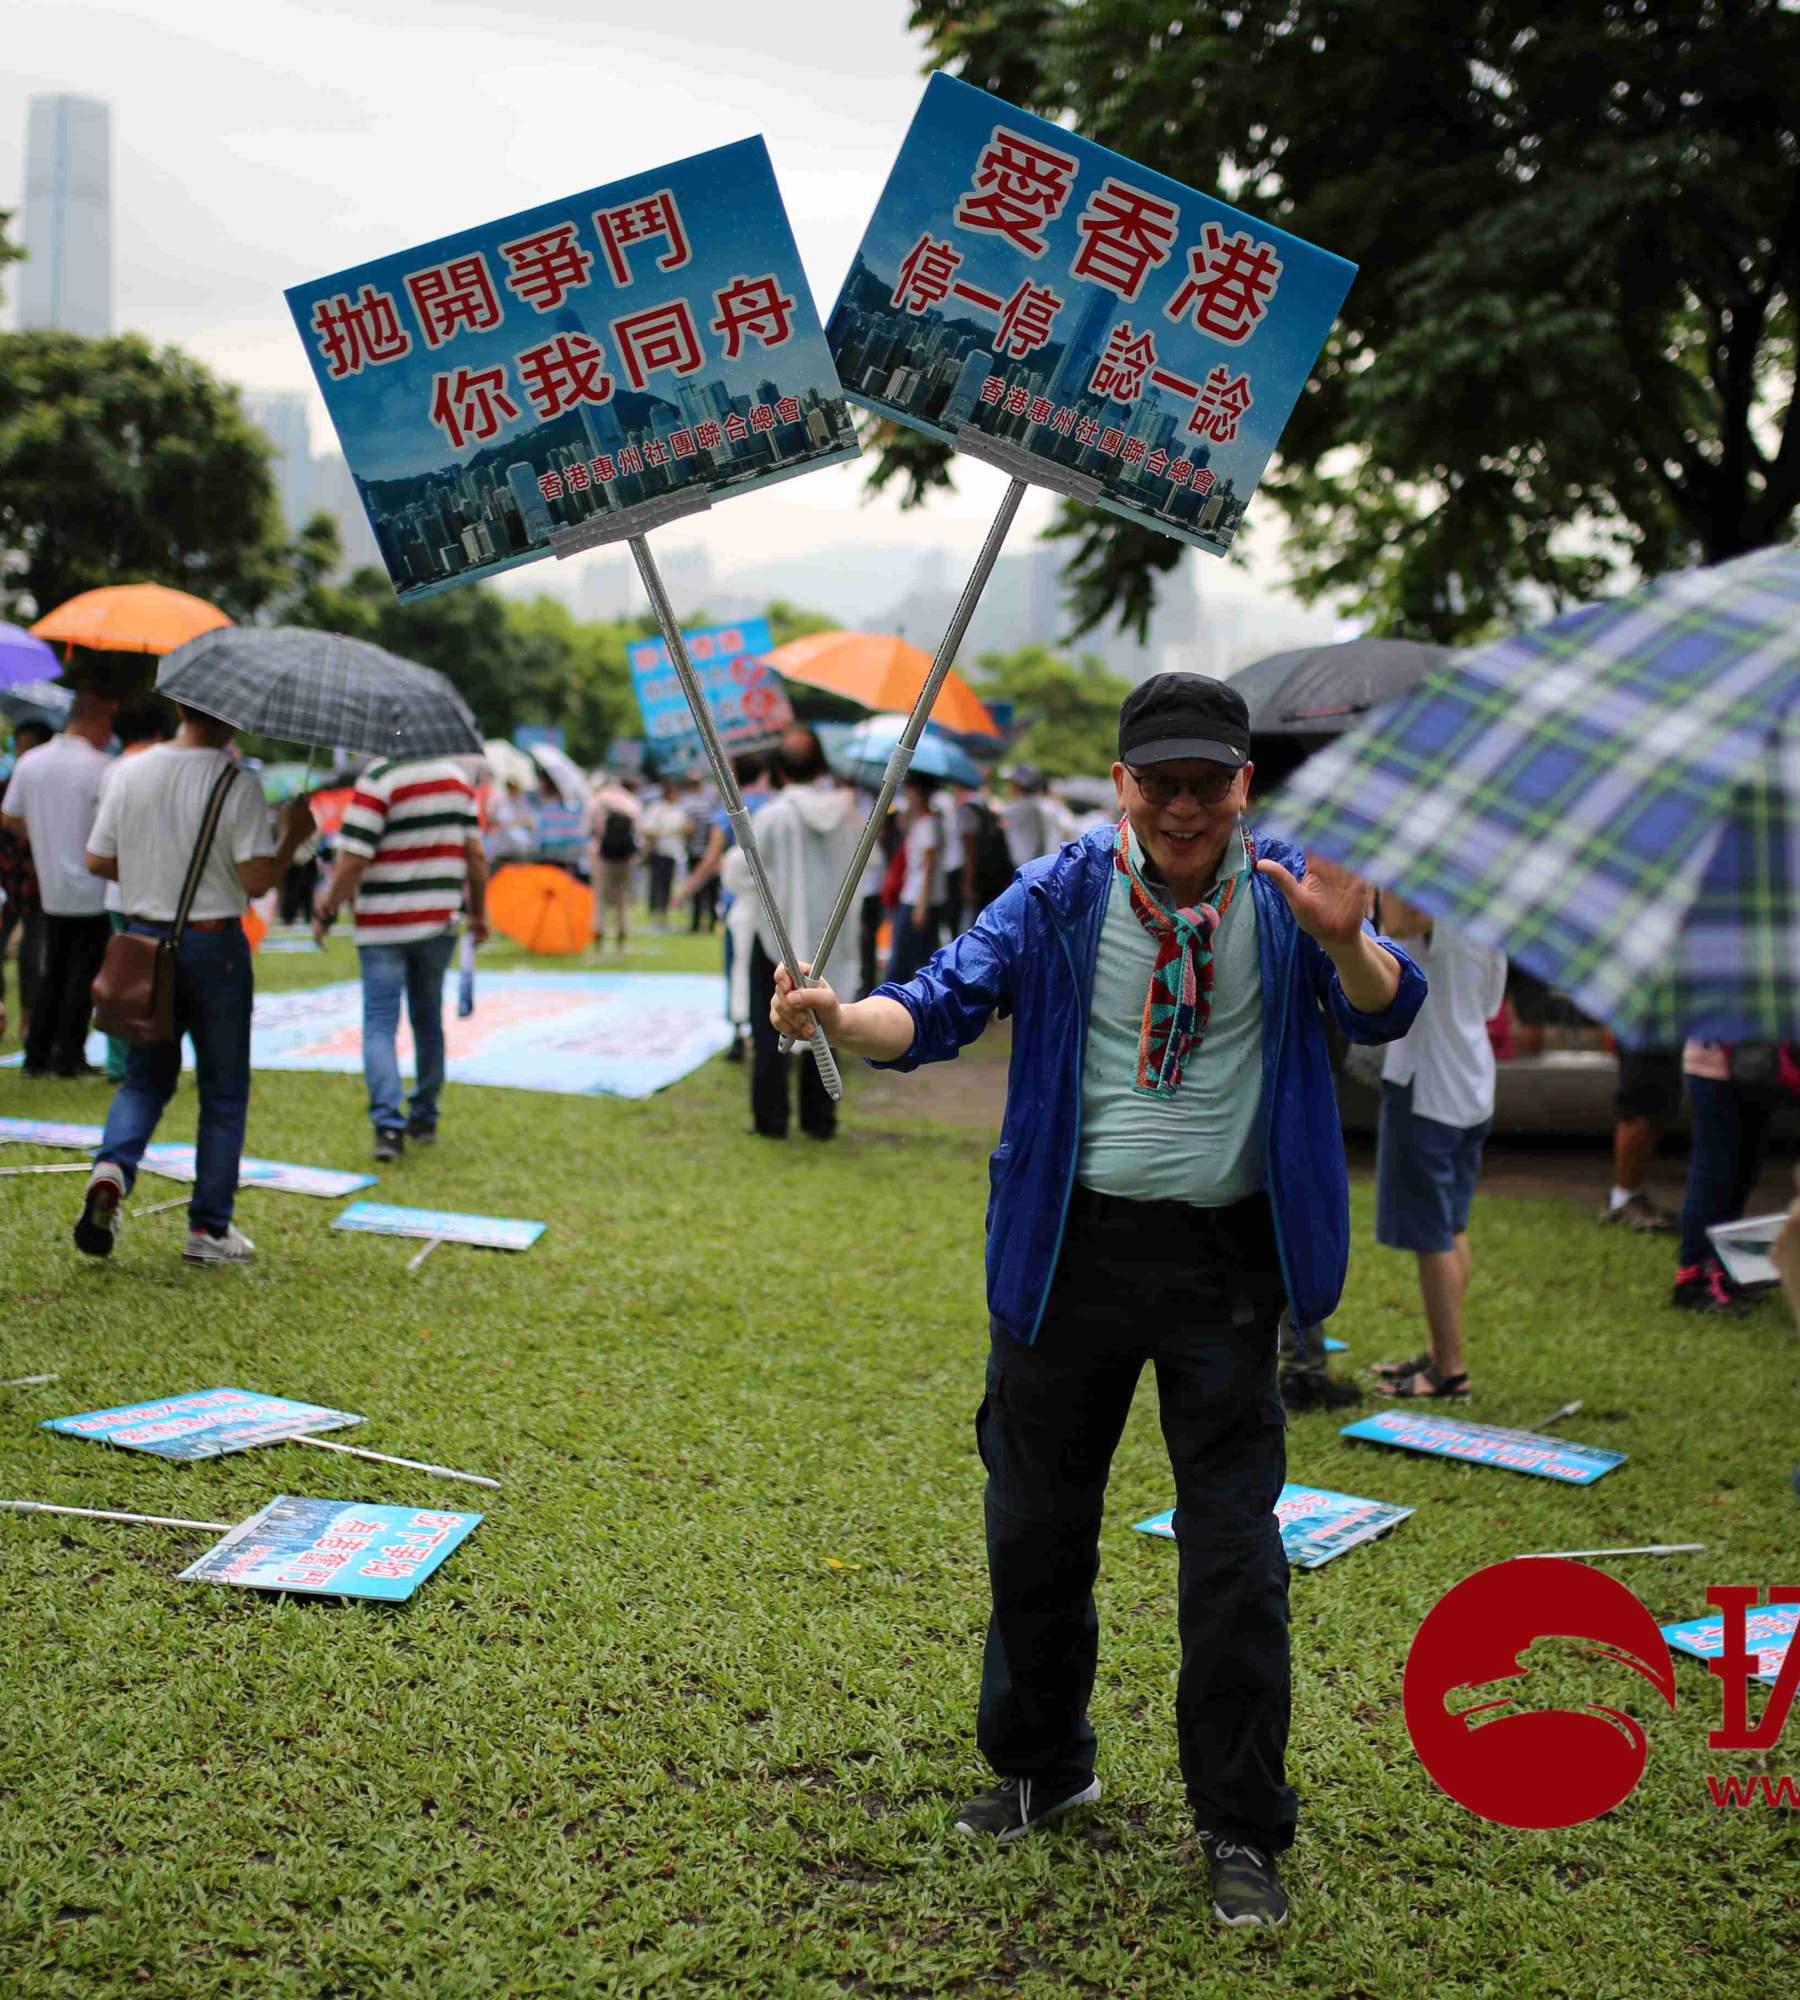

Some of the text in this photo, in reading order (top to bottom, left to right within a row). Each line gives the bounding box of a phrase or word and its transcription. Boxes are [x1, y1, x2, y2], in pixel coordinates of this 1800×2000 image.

[956, 127, 1282, 346] 愛香港
[429, 275, 795, 449] 你我同舟
[892, 233, 1252, 443] 停一停 諗一諗
[538, 395, 802, 501] 香港惠州社團聯合總會
[980, 376, 1217, 496] 香港惠州社團聯合總會
